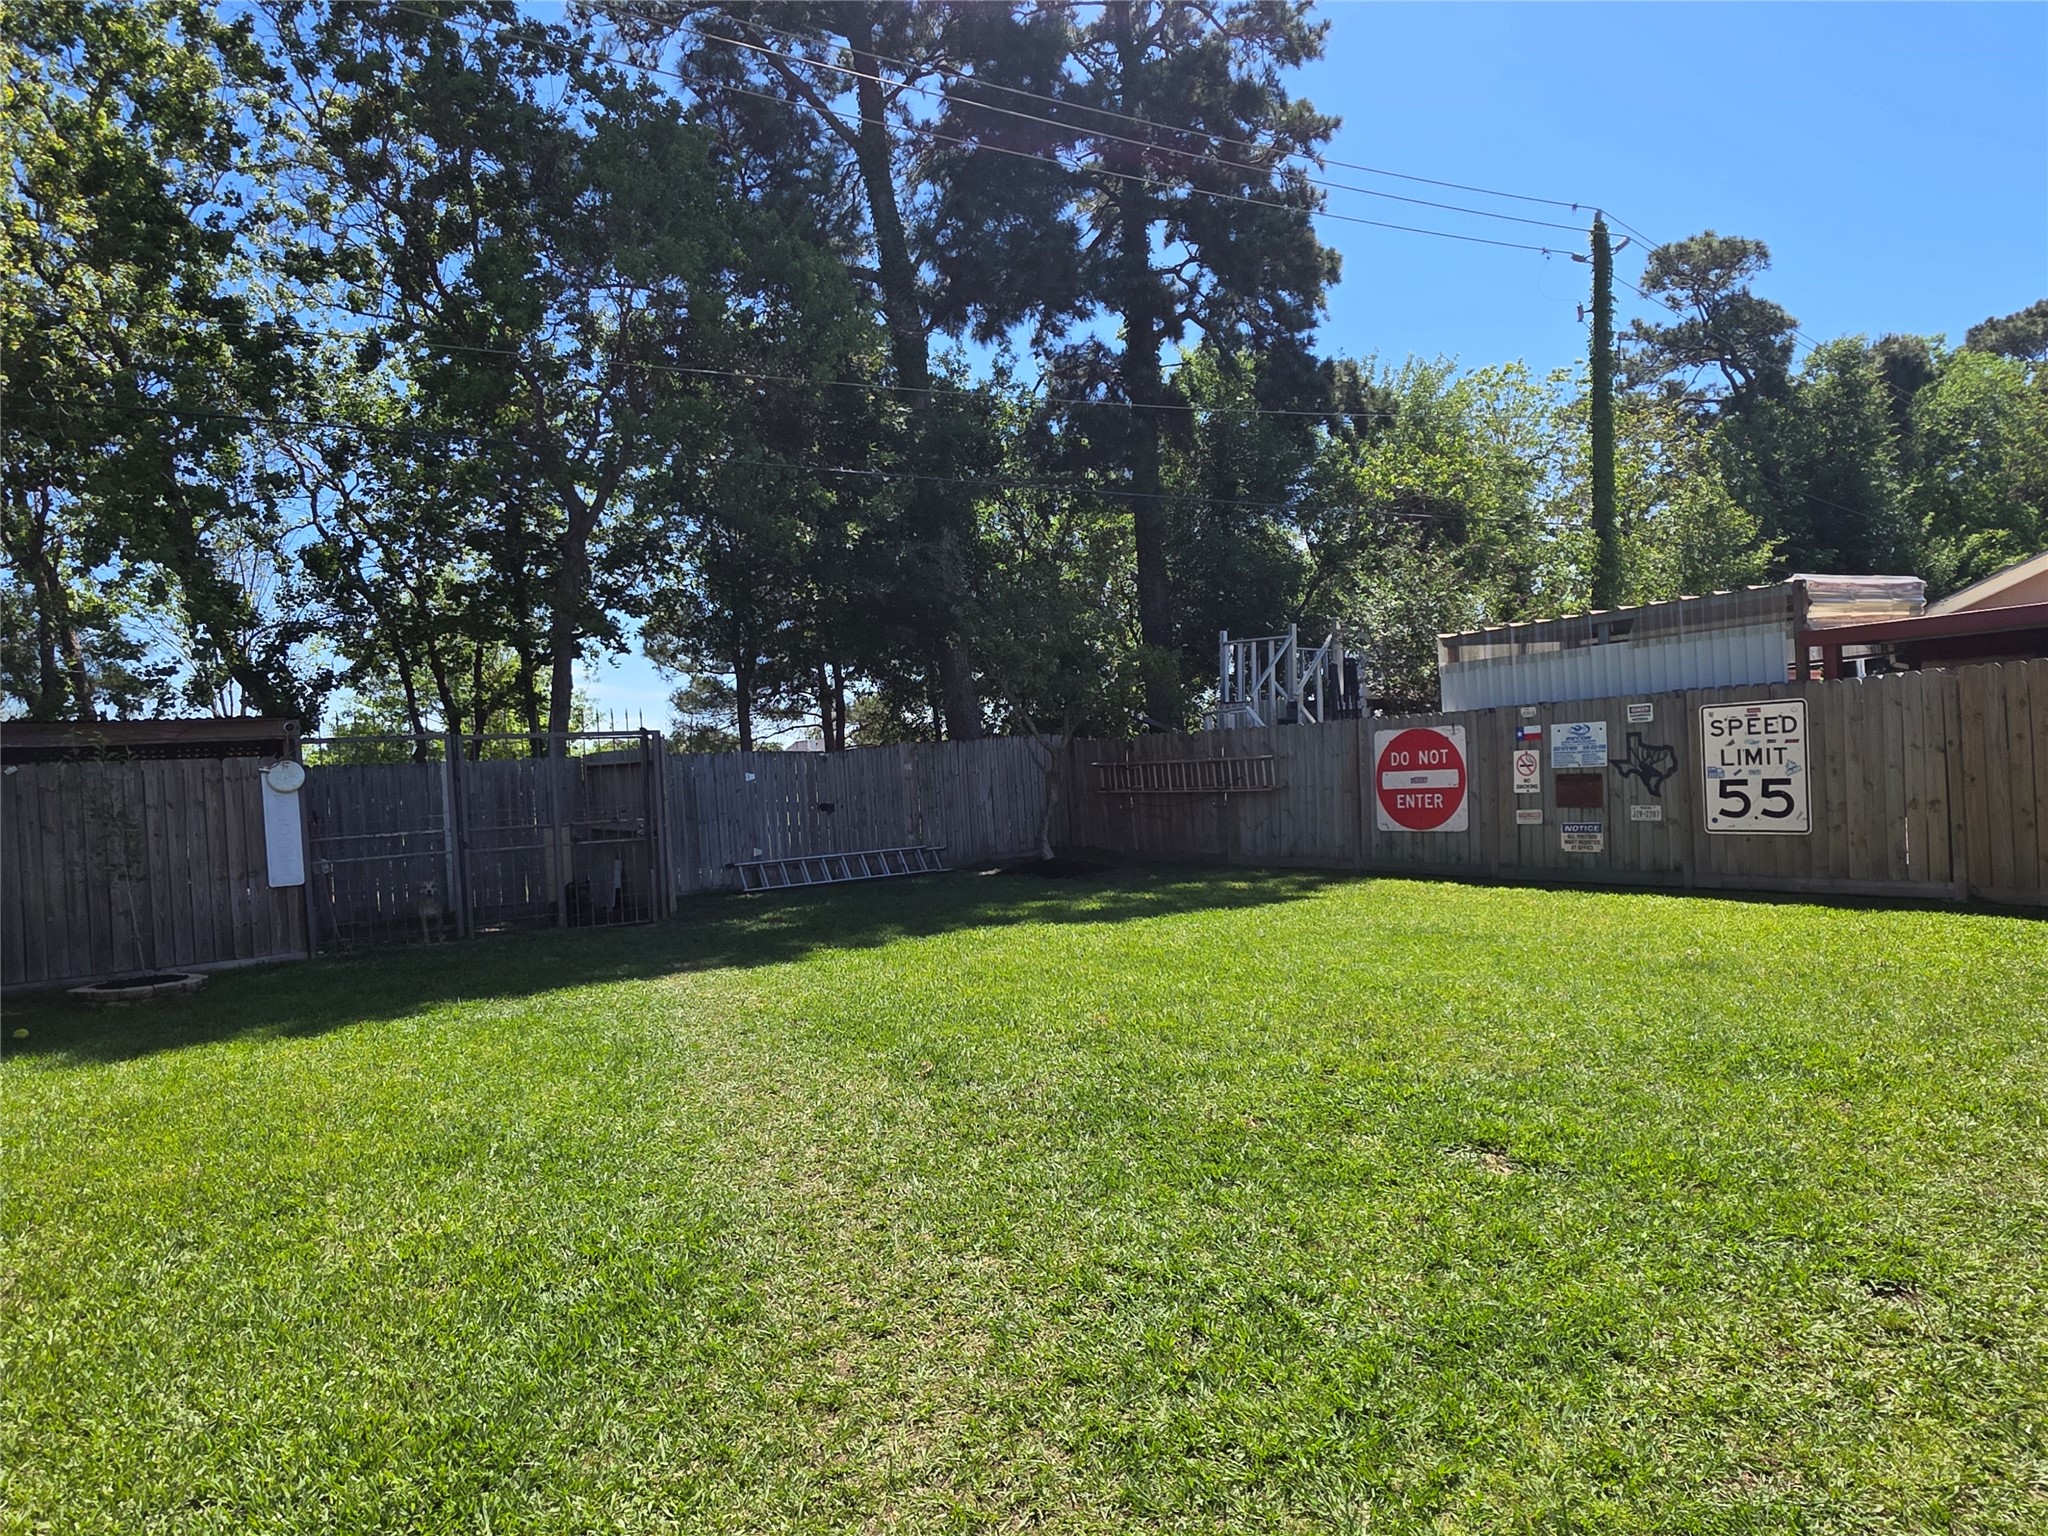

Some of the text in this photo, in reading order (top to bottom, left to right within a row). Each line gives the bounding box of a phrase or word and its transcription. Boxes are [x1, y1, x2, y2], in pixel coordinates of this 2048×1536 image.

[1710, 715, 1798, 737] SPEED
[1391, 749, 1449, 766] DO NOT
[1720, 747, 1788, 766] LIMIT
[1397, 793, 1444, 809] ENTER
[1718, 778, 1795, 818] 55
